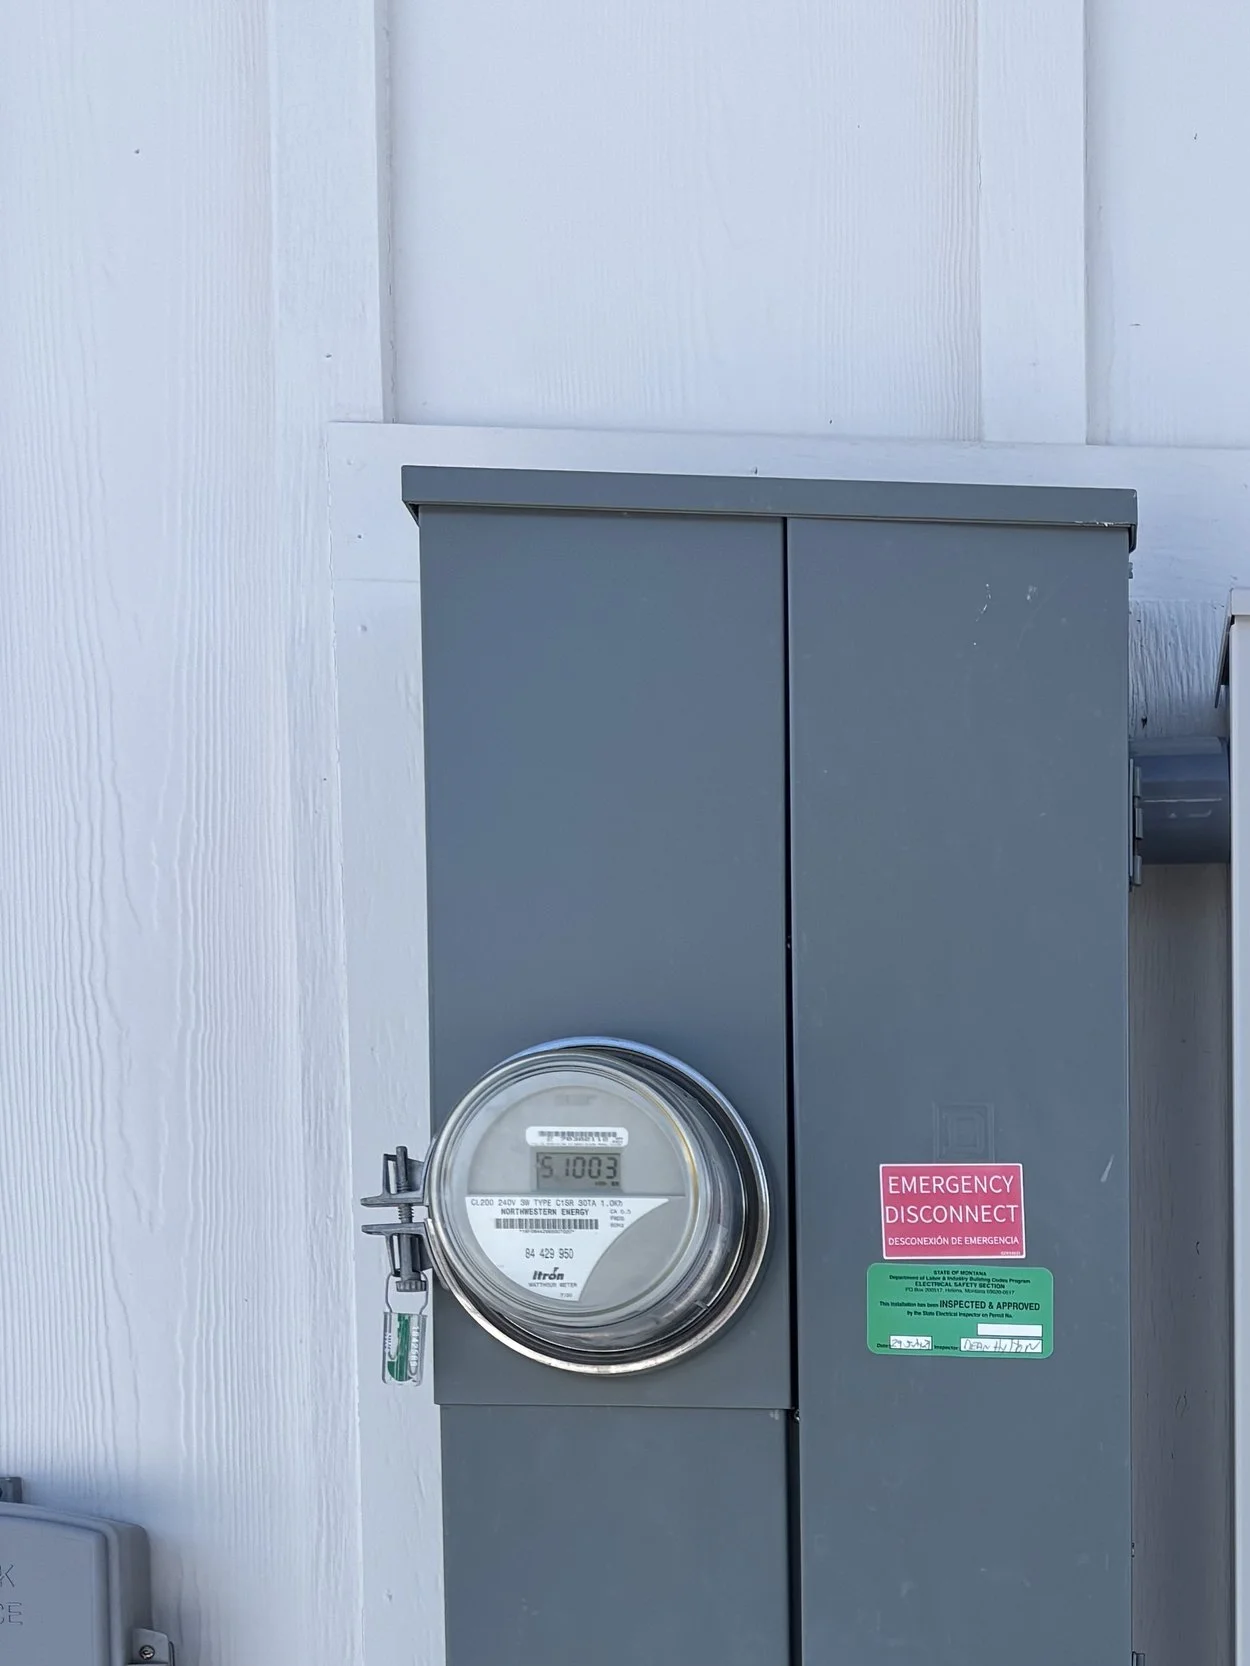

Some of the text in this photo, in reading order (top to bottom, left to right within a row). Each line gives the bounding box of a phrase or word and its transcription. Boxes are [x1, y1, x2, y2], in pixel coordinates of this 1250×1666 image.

[888, 1175, 1014, 1194] EMERGENCY
[501, 1208, 589, 1216] NORTHWESTERN ENERGY
[885, 1204, 1019, 1224] DISCONNECT
[888, 1235, 1019, 1246] DESCONEXIÓN DE EMERGENCIA
[525, 1248, 574, 1259] 84 429 950
[532, 1267, 564, 1280] Itron
[940, 1300, 986, 1309] INSPECTED
[996, 1302, 1040, 1311] APPROVED
[0, 1601, 24, 1626] E
